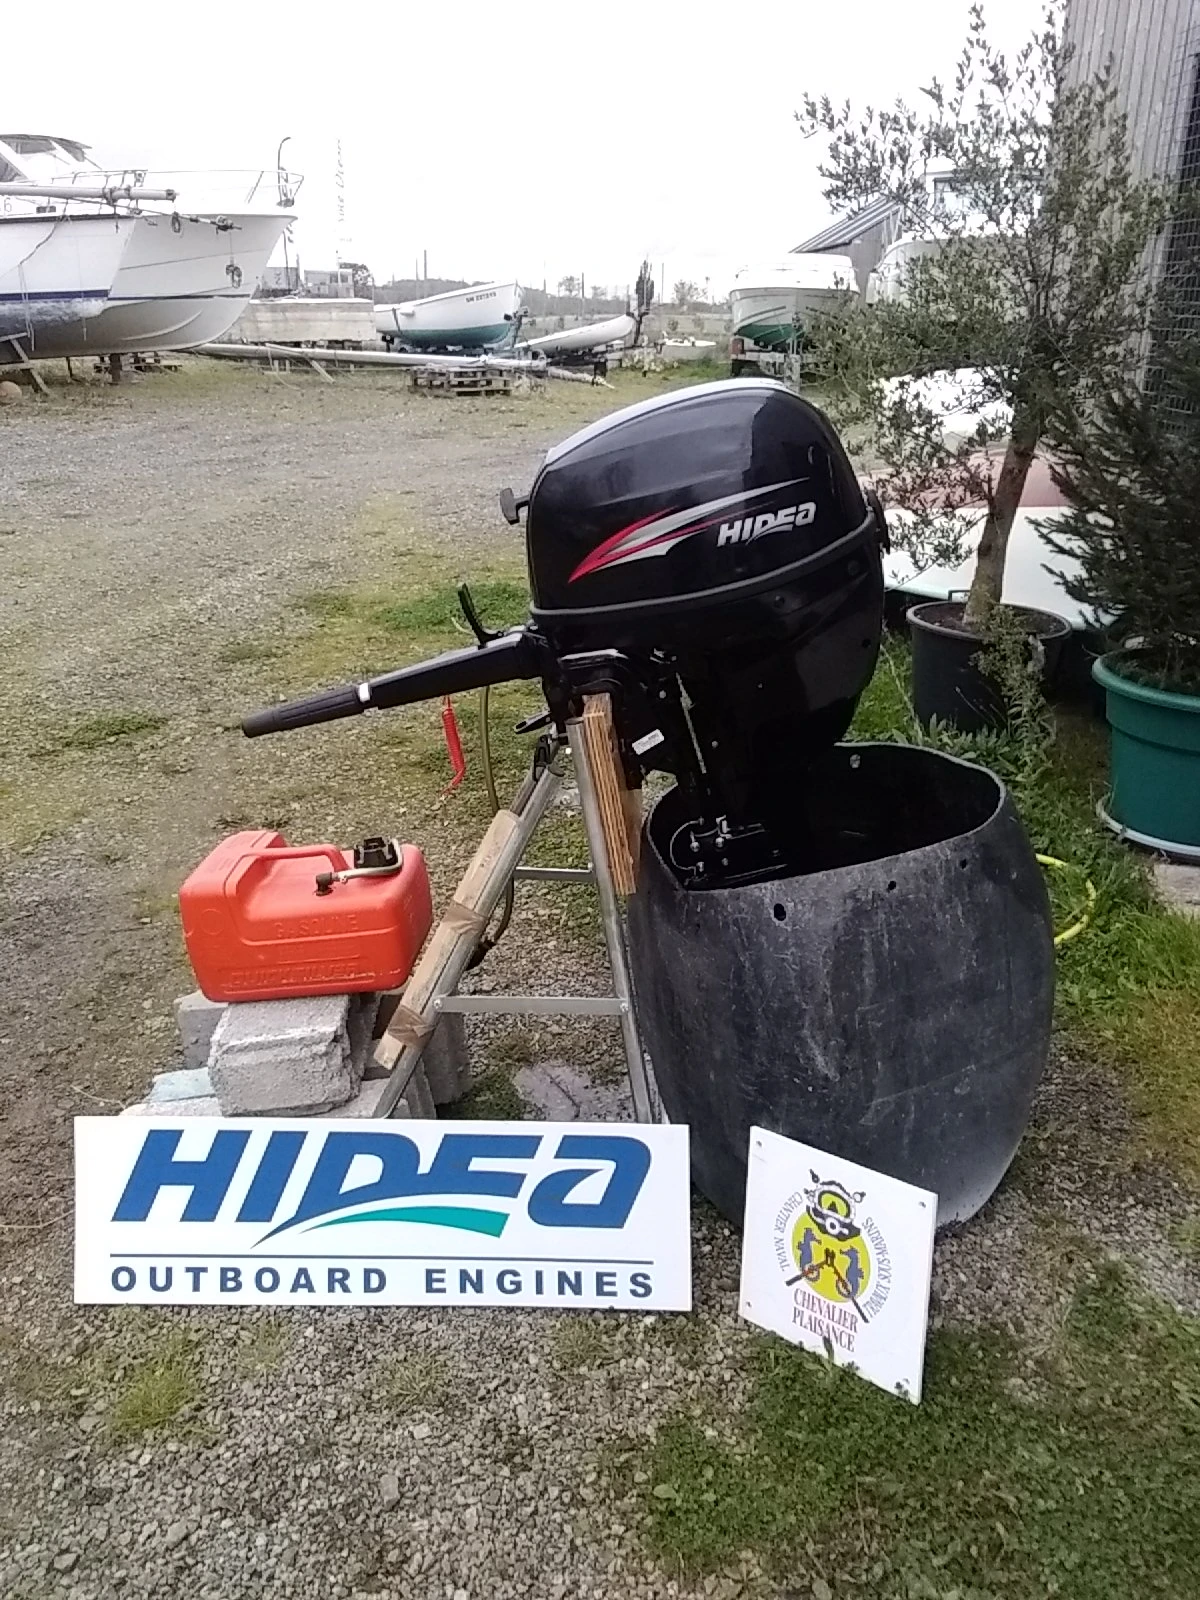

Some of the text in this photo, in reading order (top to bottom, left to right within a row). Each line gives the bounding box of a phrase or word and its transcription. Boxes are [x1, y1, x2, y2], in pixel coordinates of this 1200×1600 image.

[717, 501, 817, 547] HIDEA
[111, 1129, 653, 1249] HIDEA
[774, 1191, 803, 1271] CHANTIER NAVAL
[111, 1266, 653, 1297] OUTBOARD ENGINES
[792, 1307, 855, 1352] PLAISANCE
[793, 1288, 858, 1333] CHEVALIER
